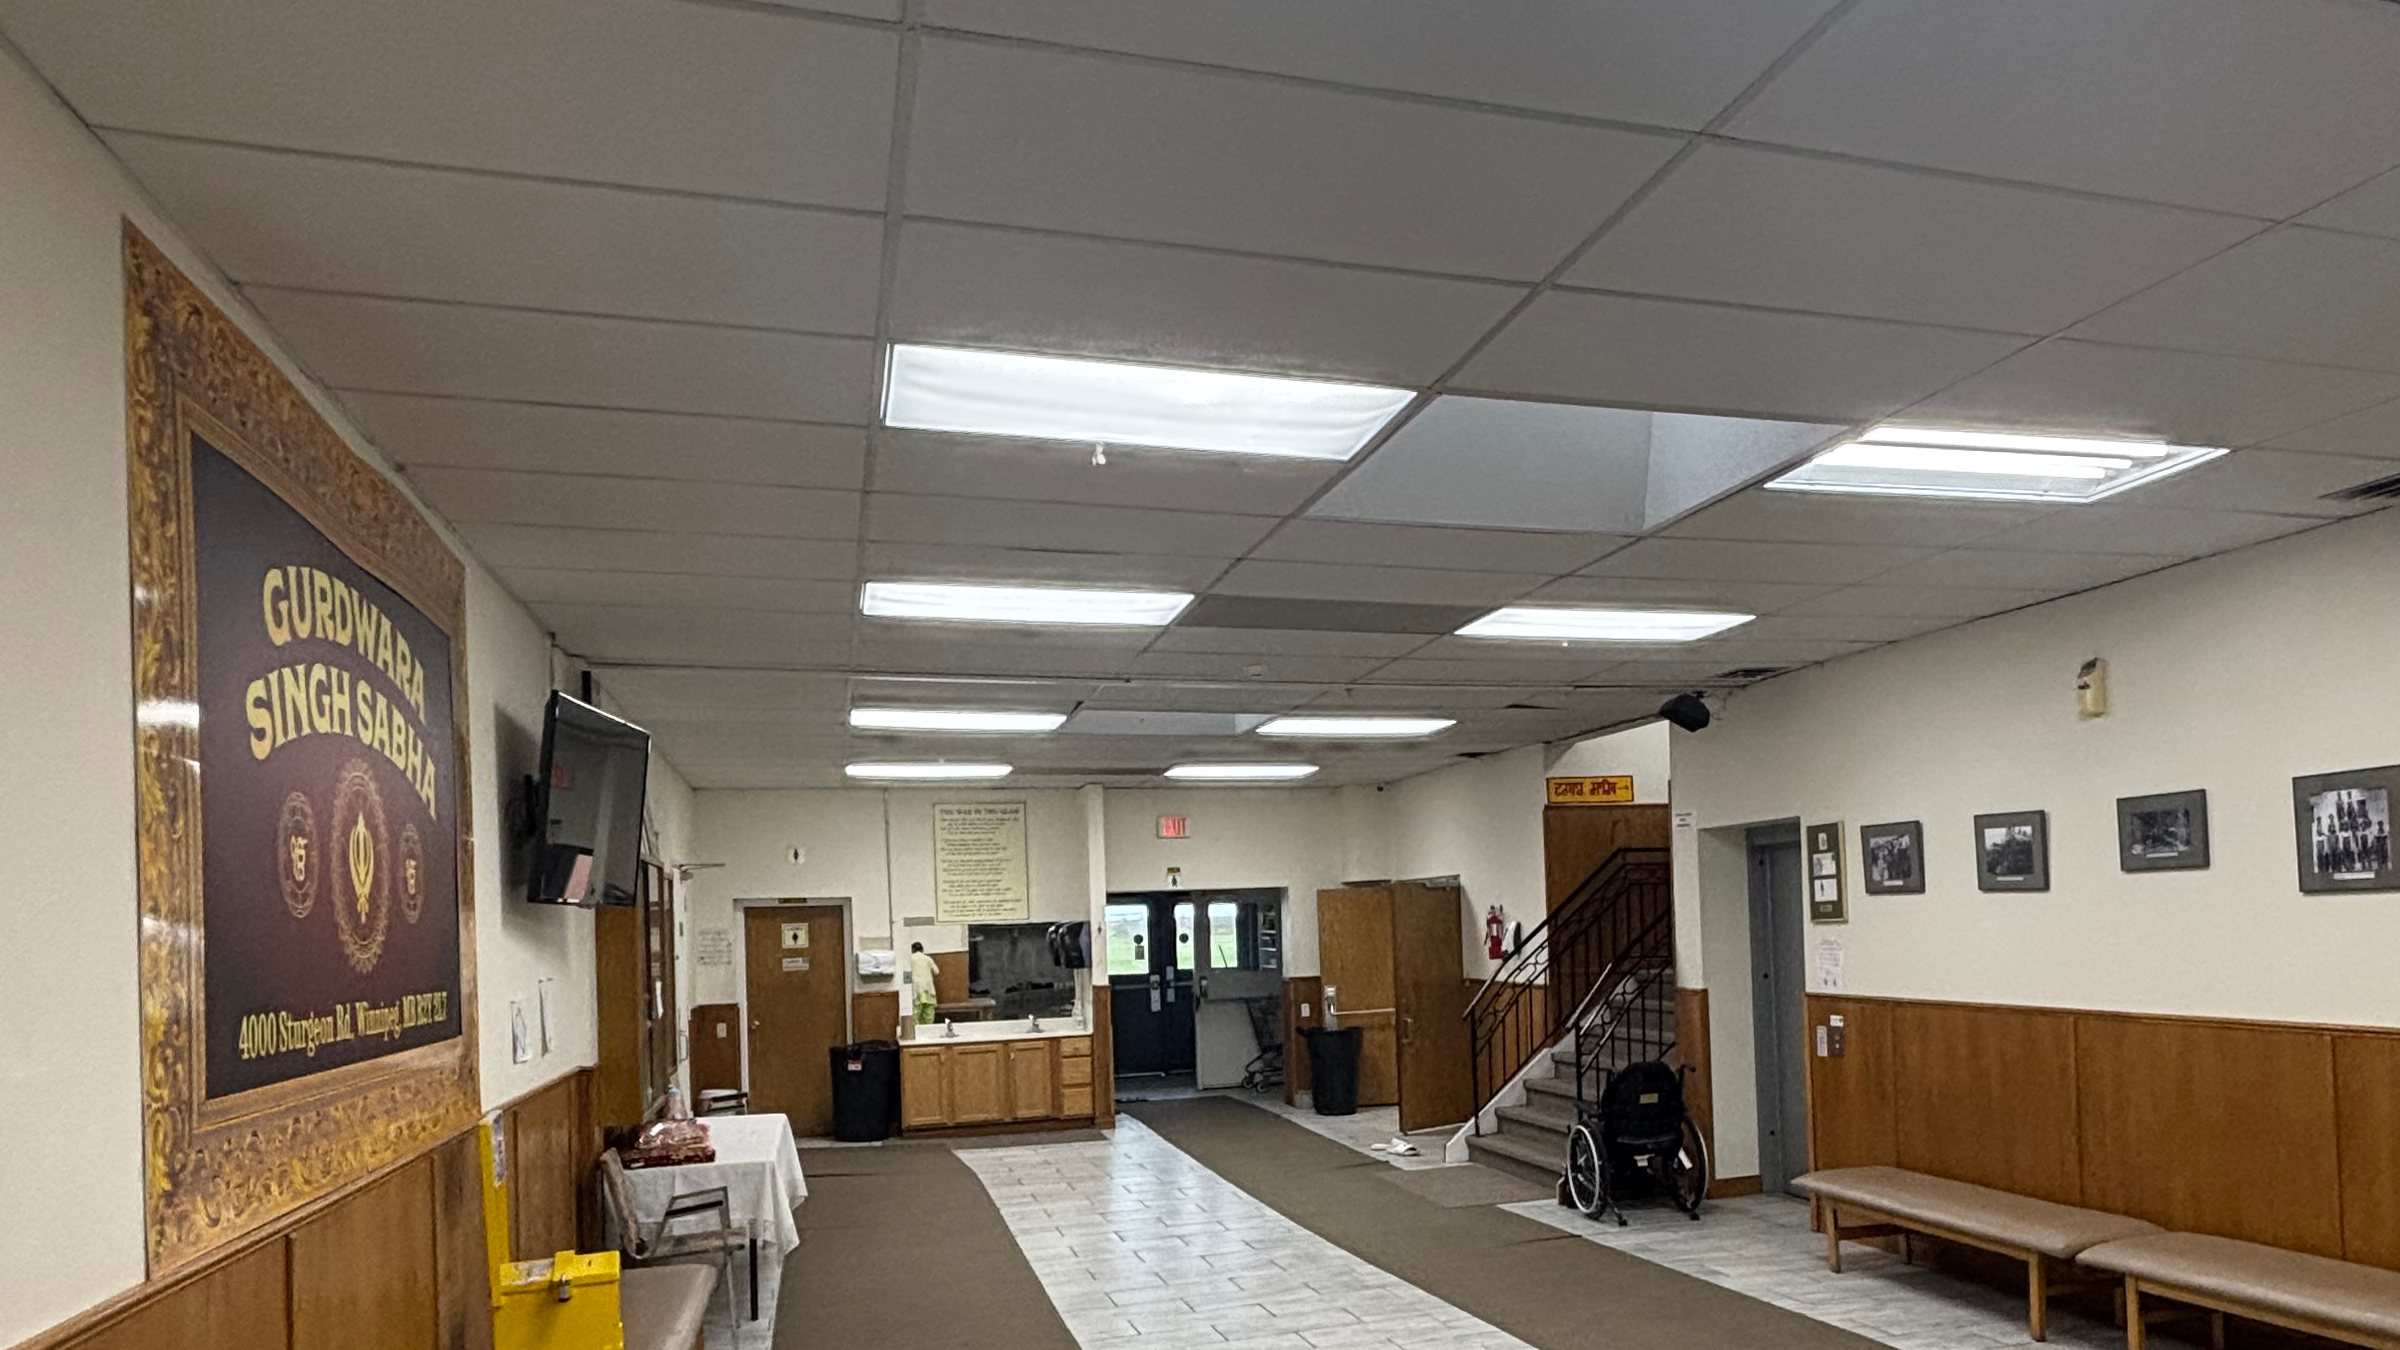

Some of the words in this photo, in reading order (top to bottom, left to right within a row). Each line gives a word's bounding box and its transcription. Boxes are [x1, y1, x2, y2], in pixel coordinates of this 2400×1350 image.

[263, 565, 425, 726] GURDWARA
[246, 662, 353, 760] SINGH
[357, 680, 436, 820] SABHA
[239, 1013, 277, 1059] 4000
[279, 1010, 335, 1057] Sturgeon
